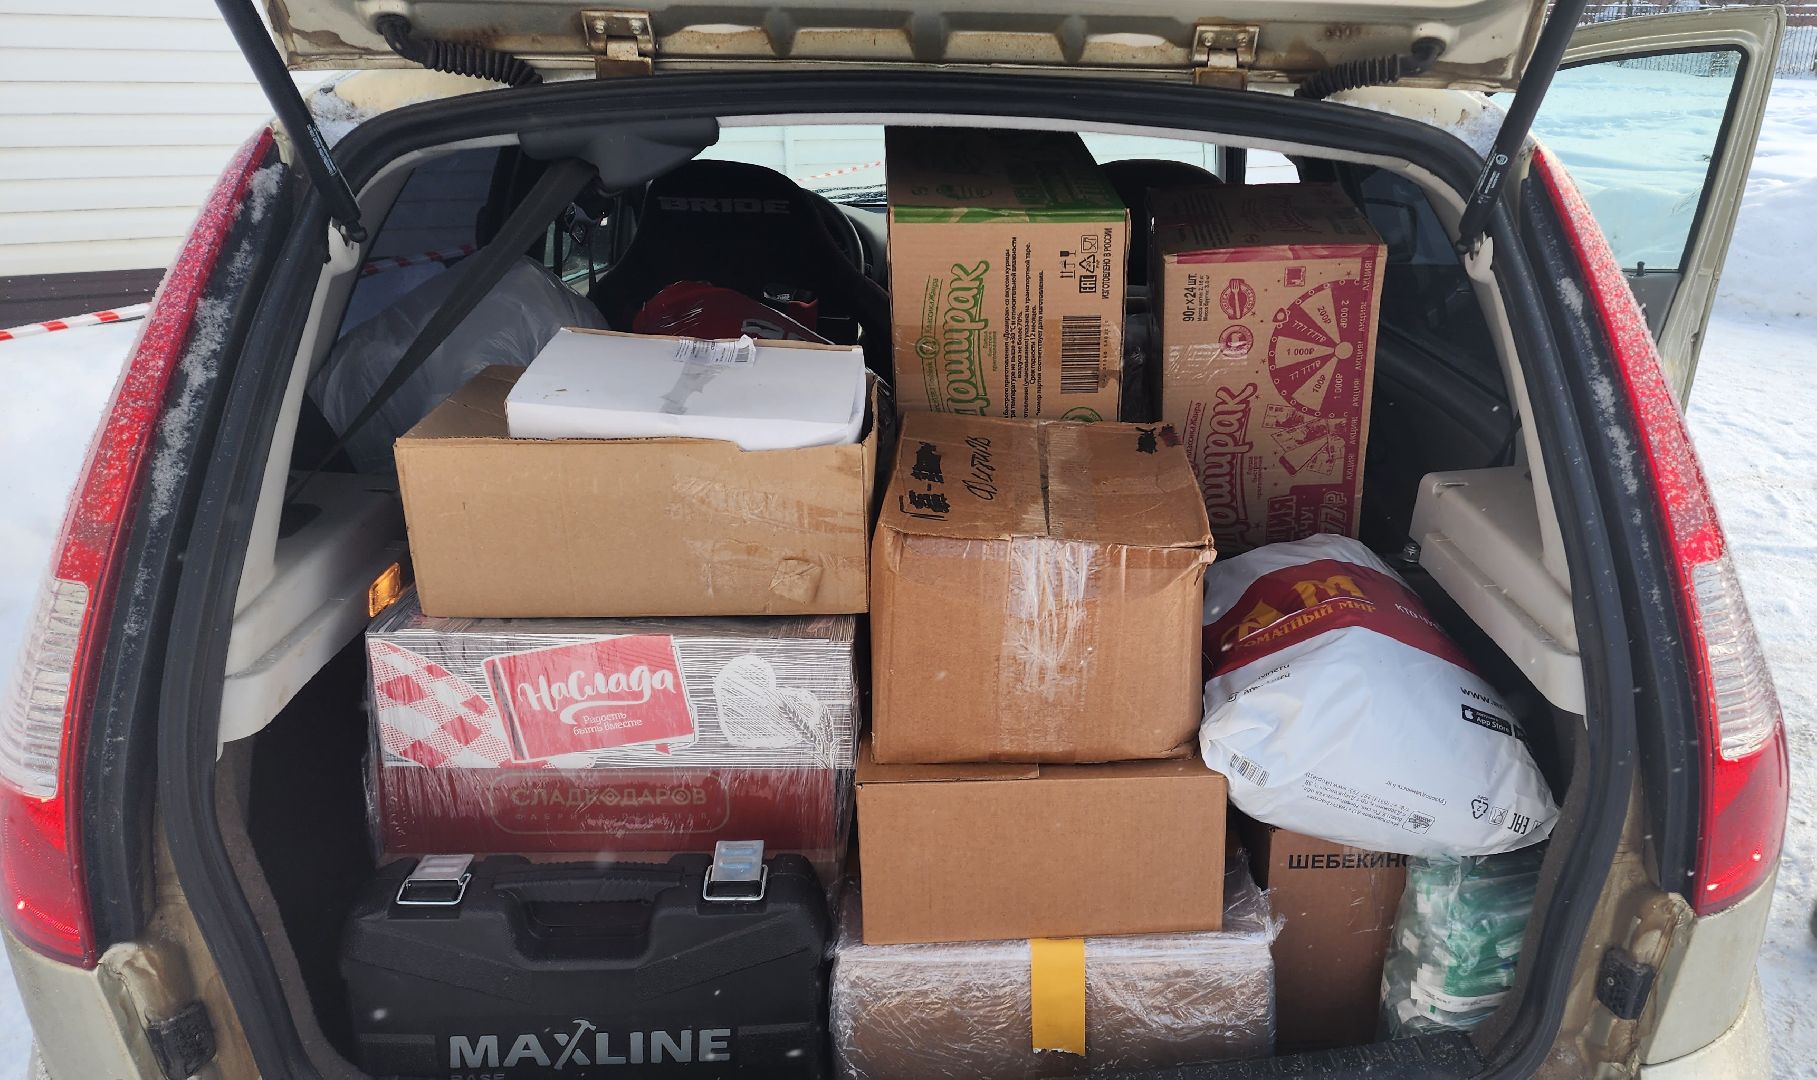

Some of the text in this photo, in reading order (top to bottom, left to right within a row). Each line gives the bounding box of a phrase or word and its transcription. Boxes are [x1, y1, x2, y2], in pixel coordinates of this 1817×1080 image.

[656, 196, 791, 214] BRIDE
[1104, 228, 1112, 251] РОССИИ
[1102, 259, 1111, 299] ИЗГОТОВЛЕНО
[1184, 287, 1196, 298] 24
[944, 260, 991, 417] Доширак
[1243, 600, 1376, 647] ОМАТНЫЙ МИР
[583, 712, 627, 724] Радость
[1476, 716, 1491, 726] App
[1492, 721, 1509, 732] Store
[573, 725, 604, 736] быть
[511, 789, 708, 806] СЛАДКОДАРОВ
[450, 1018, 730, 1070] MAXLINE
